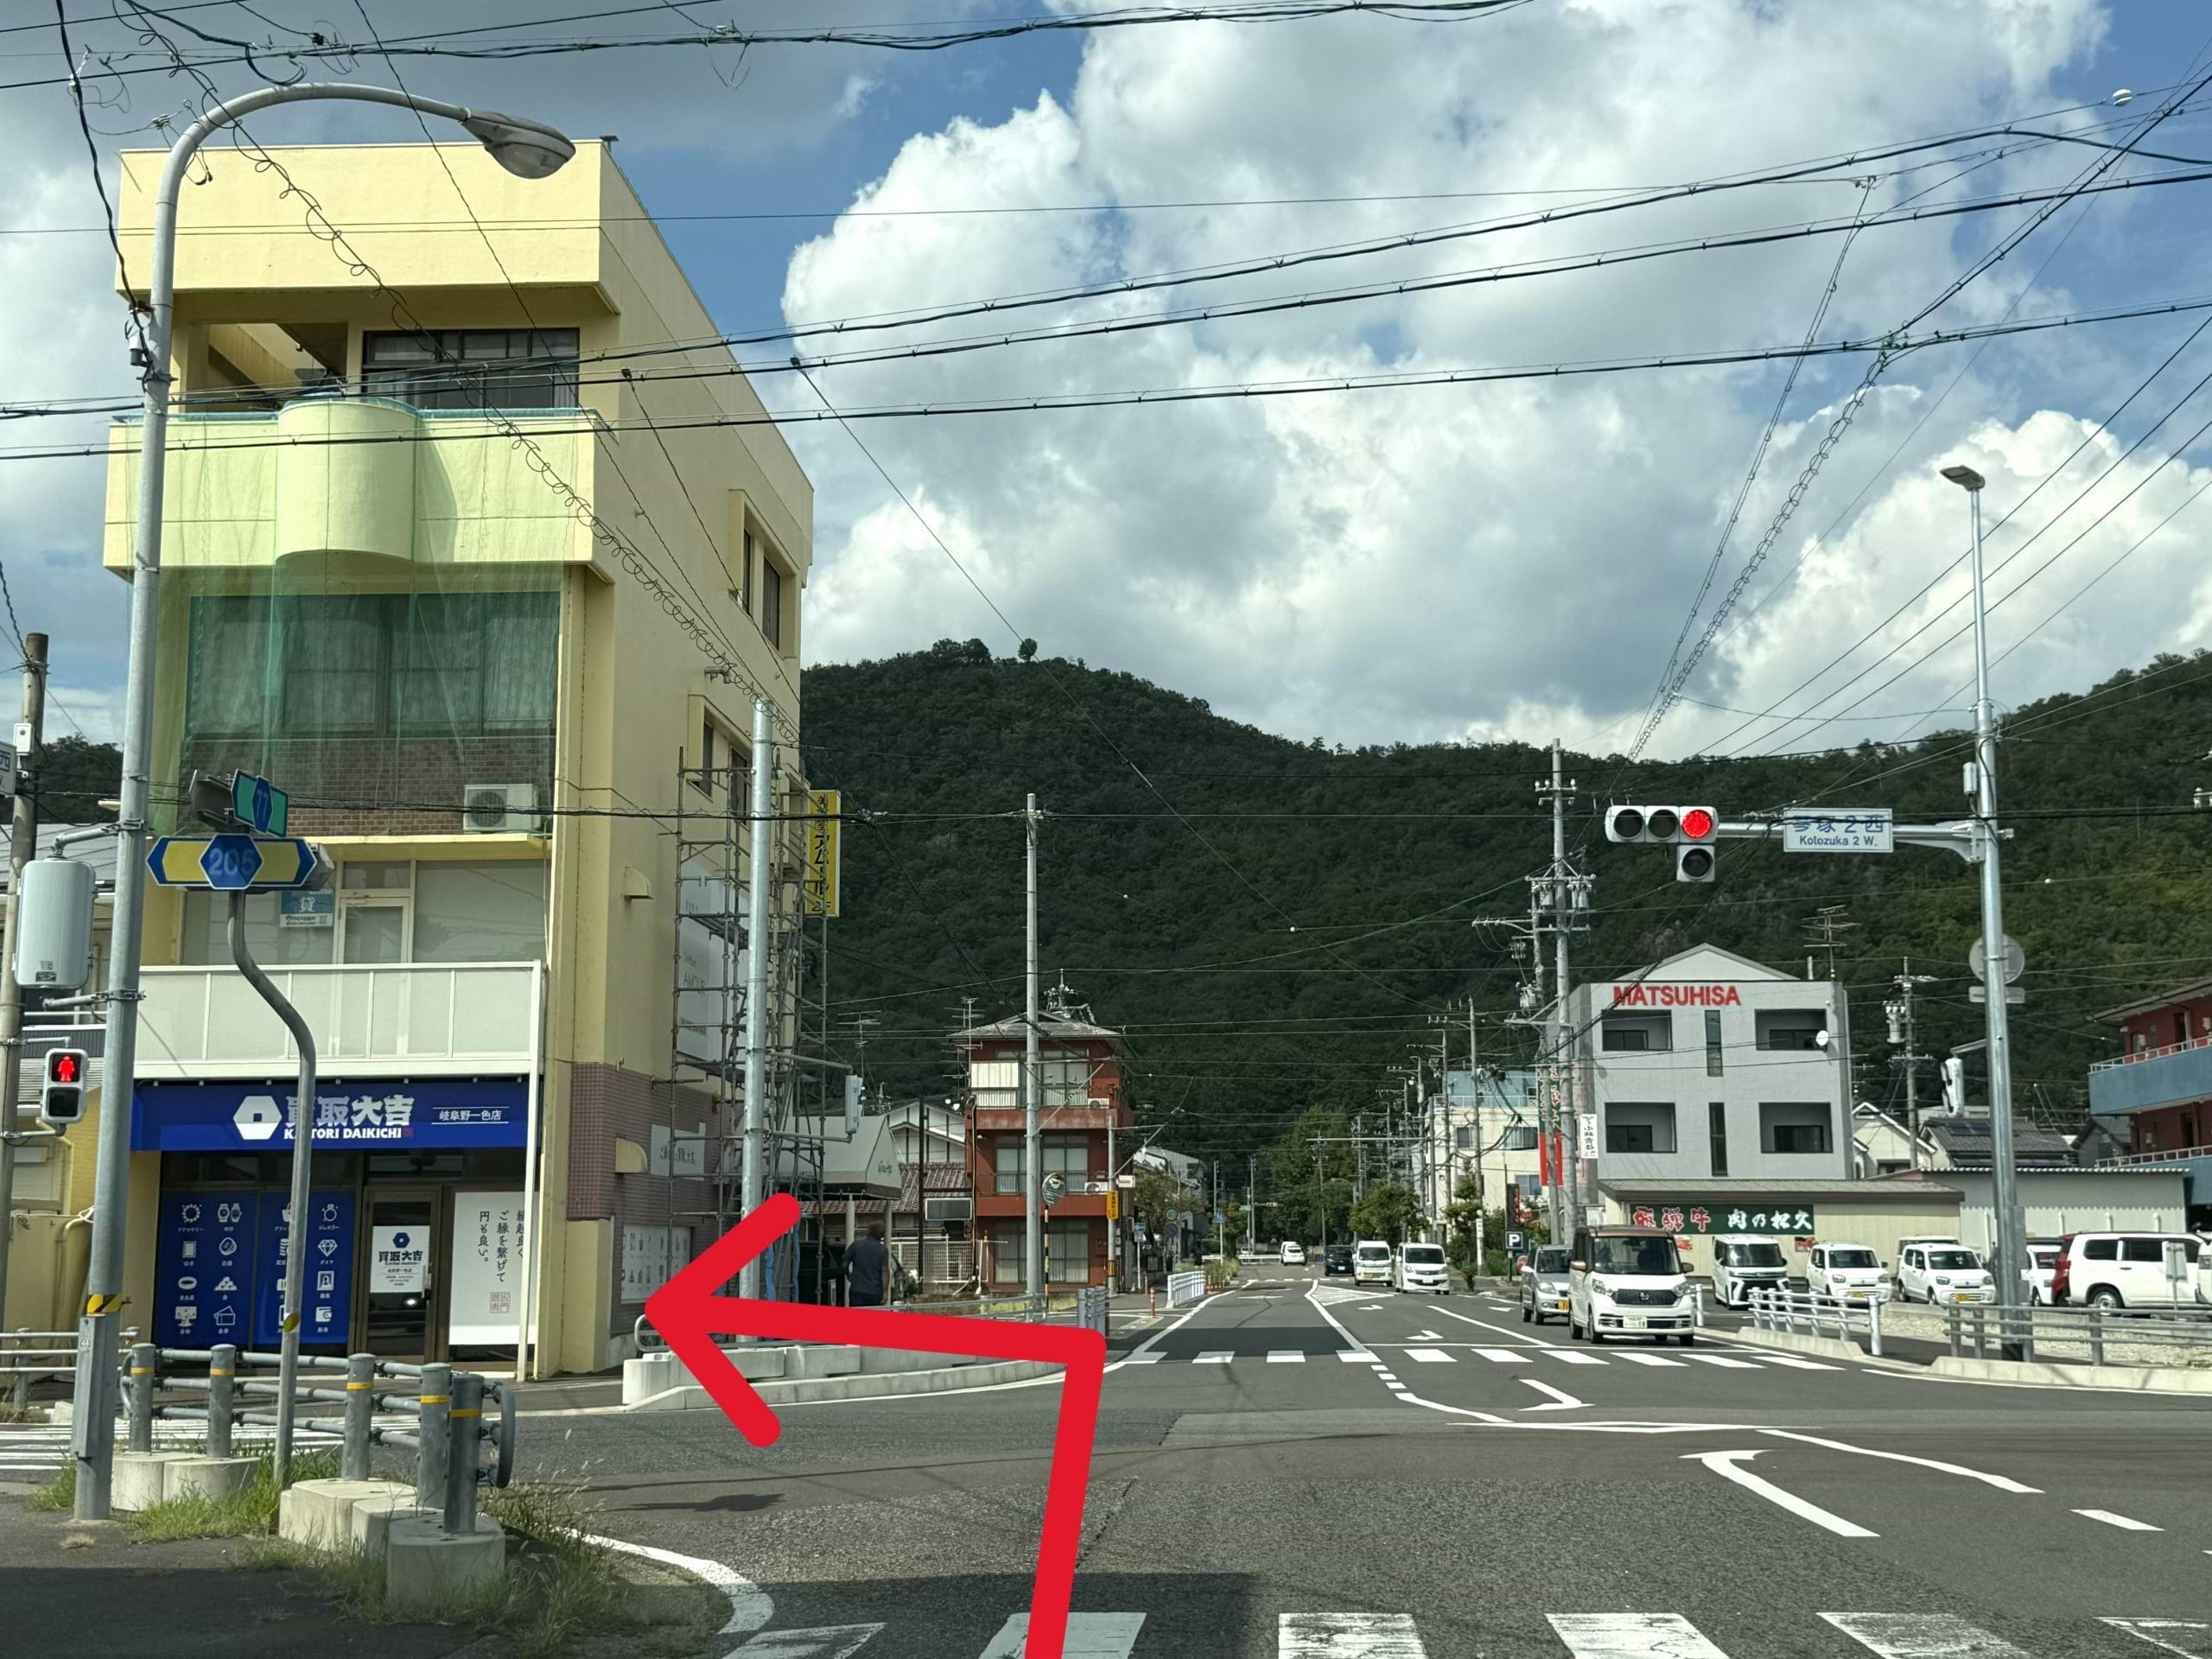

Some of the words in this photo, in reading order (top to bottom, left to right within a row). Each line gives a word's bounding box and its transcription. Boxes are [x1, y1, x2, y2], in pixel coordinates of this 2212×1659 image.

[1799, 836, 1849, 846] Kotozuka
[1853, 836, 1859, 846] 2
[208, 849, 256, 876] 205
[1612, 984, 1742, 1007] MATSUHISA
[439, 1109, 502, 1122] 岐阜野一色店
[283, 1128, 340, 1139] KTORI
[342, 1128, 402, 1139] DAIKICHI
[478, 1211, 490, 1262] 円も良い。
[1508, 1233, 1521, 1247] P
[496, 1210, 510, 1282] ご縁を繋げて
